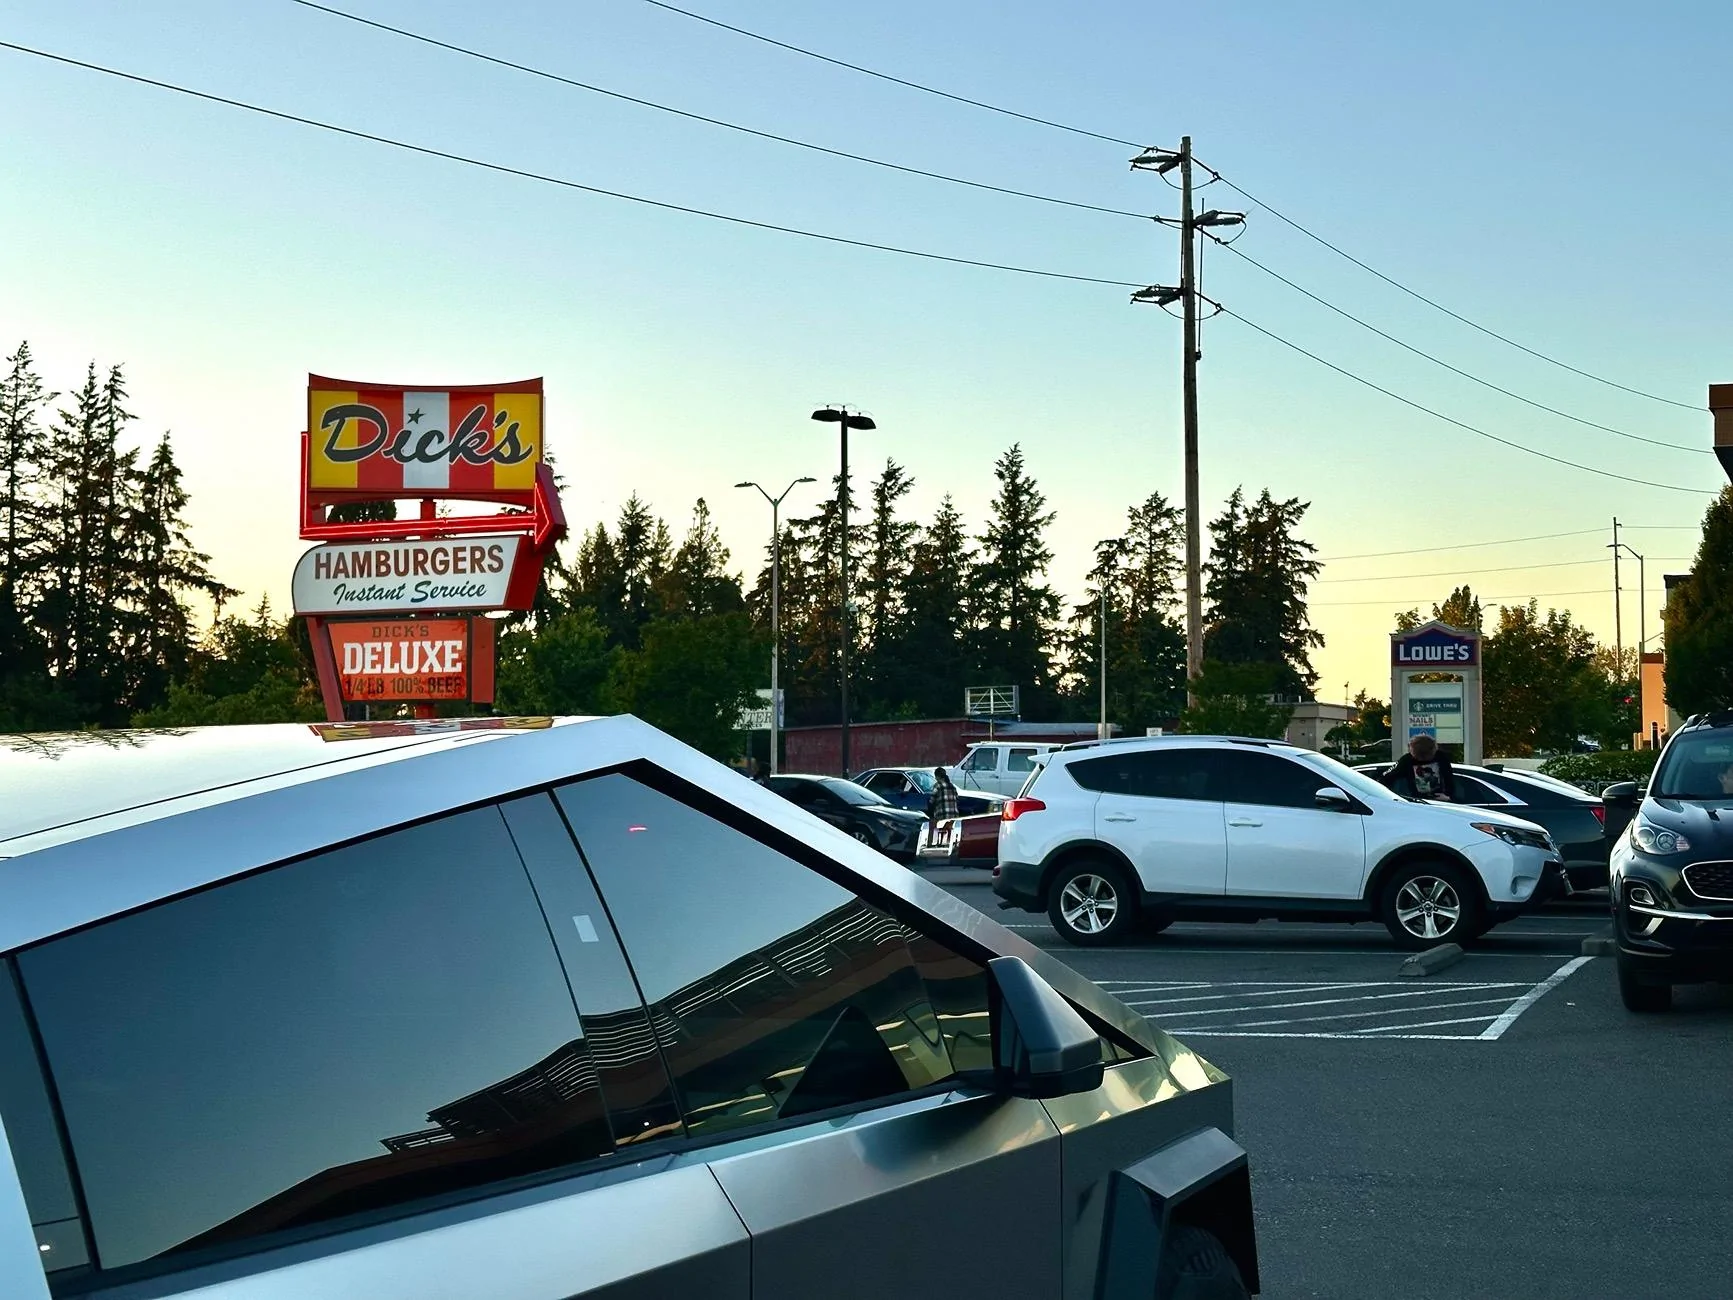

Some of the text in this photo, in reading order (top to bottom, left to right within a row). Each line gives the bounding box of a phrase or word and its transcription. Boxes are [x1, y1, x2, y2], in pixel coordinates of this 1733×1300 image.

[321, 403, 534, 465] Dick's
[314, 544, 504, 580] HAMBURGERS
[333, 580, 487, 605] Instant Service
[372, 624, 430, 638] DICK'S
[342, 640, 463, 675] DELUXE
[1399, 643, 1470, 661] LOWE'S
[391, 676, 424, 694] 100%
